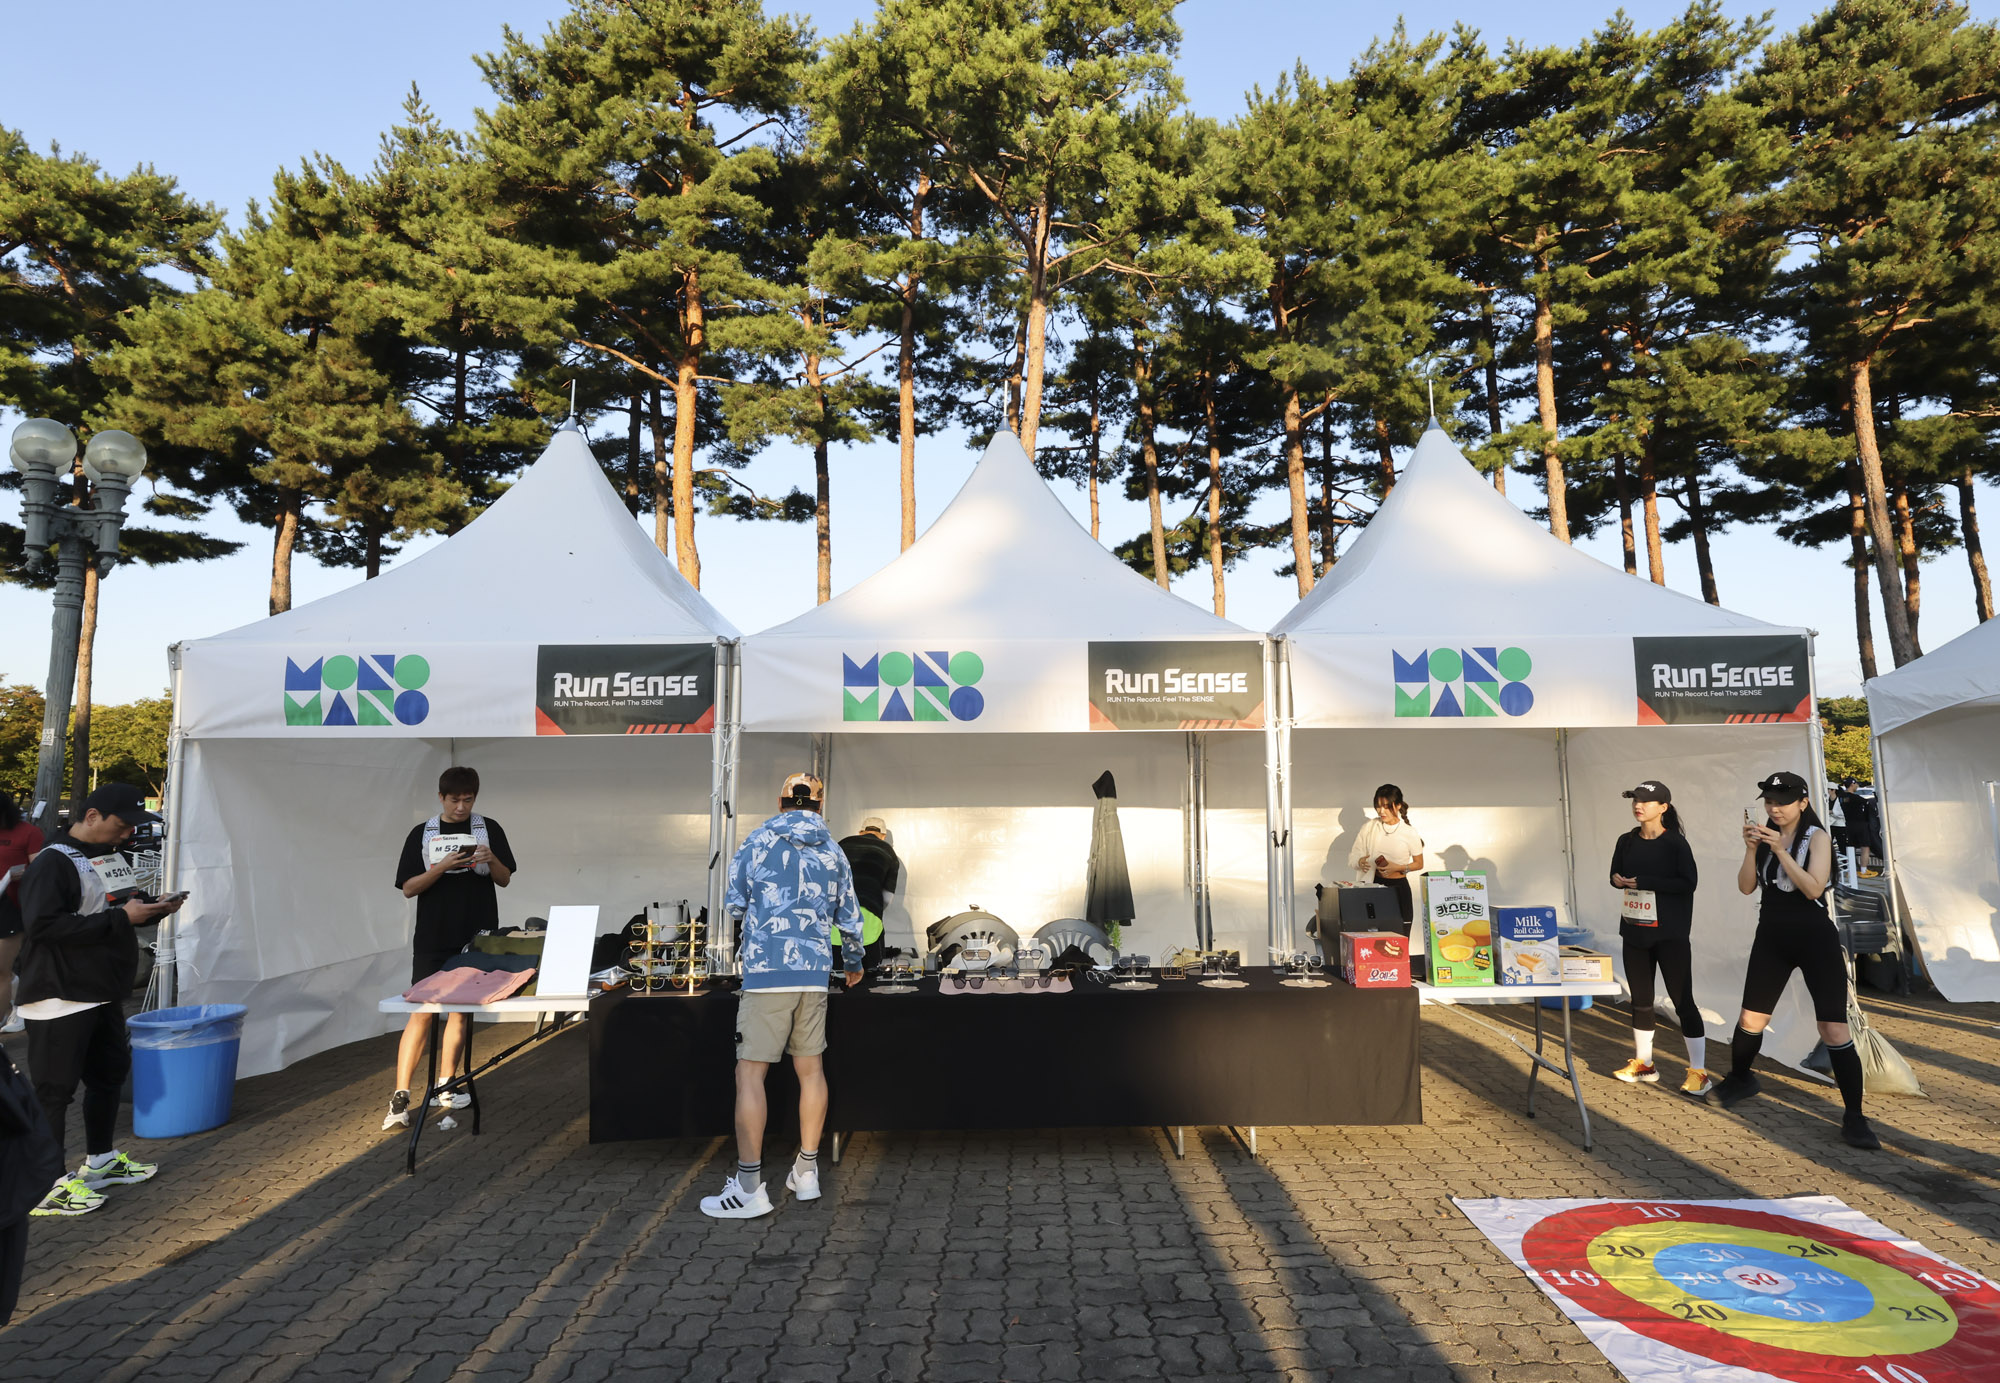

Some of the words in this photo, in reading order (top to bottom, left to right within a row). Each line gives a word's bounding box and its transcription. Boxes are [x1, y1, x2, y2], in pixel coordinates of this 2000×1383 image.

[285, 654, 430, 691] MONO
[842, 651, 984, 687] MONO
[1392, 646, 1532, 682] MONO
[284, 690, 430, 726] MANO
[842, 686, 984, 722] MANO
[1394, 682, 1534, 717] MANO
[1436, 902, 1482, 915] 카스타드
[1515, 916, 1542, 927] Milk
[1632, 1206, 1682, 1218] 10
[1598, 1244, 1645, 1258] 20
[1700, 1248, 1744, 1262] 30
[1787, 1243, 1838, 1258] 20
[1544, 1269, 1600, 1286] 10
[1675, 1272, 1721, 1285] 30
[1738, 1273, 1779, 1286] 50
[1795, 1272, 1844, 1286] 30
[1916, 1272, 1981, 1291] 10
[1672, 1303, 1728, 1321] 20
[1773, 1300, 1825, 1316] 30
[1888, 1305, 1949, 1322] 20
[1856, 1363, 1928, 1383] 10
